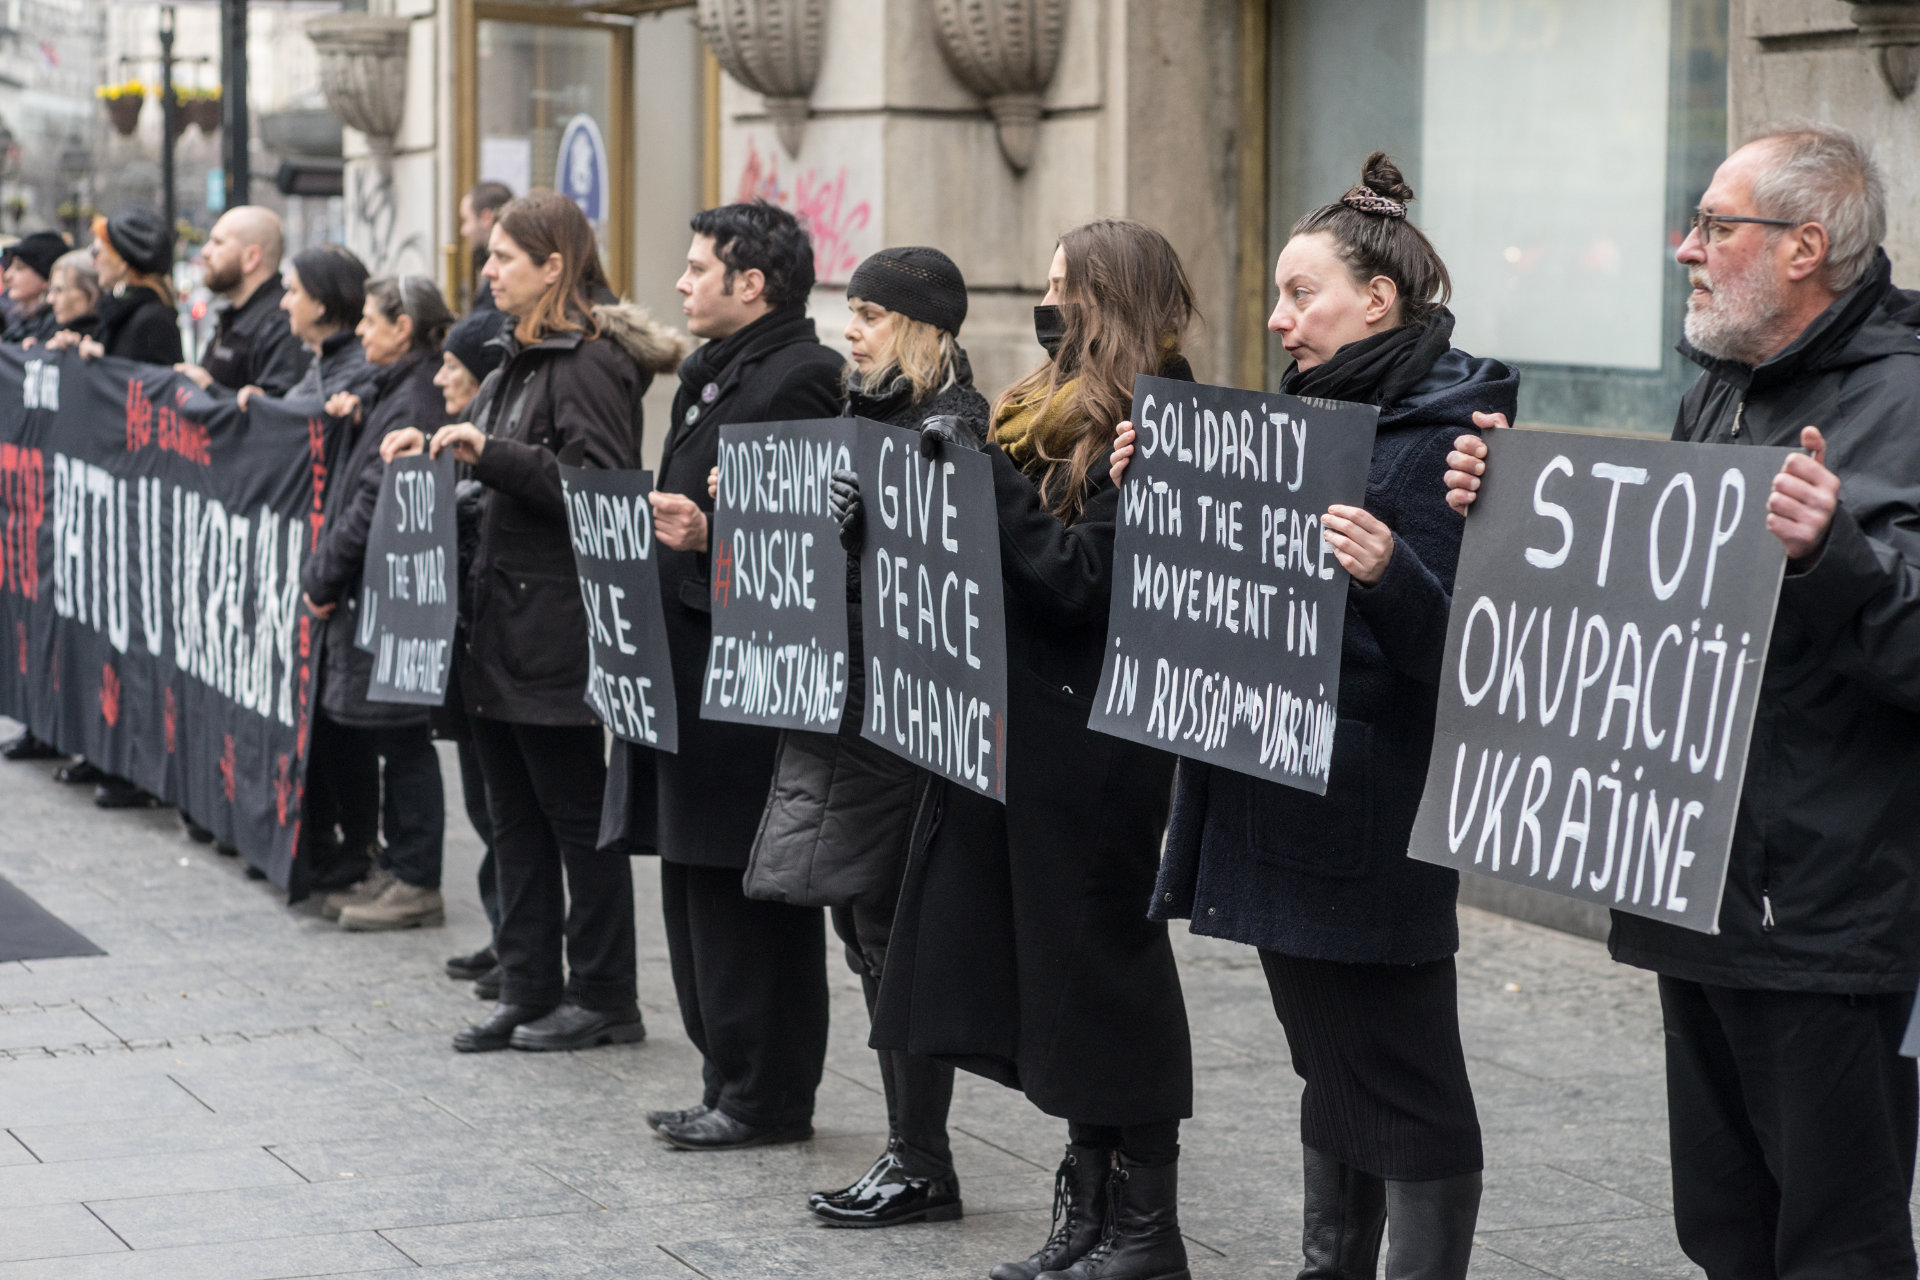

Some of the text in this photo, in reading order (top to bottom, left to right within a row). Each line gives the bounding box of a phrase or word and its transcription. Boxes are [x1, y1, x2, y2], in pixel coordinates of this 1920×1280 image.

[0, 442, 45, 603] TOP
[395, 470, 436, 533] STOP
[878, 437, 959, 553] GIVE
[1198, 496, 1244, 551] THE
[1261, 504, 1335, 580] PEACE
[1525, 455, 1746, 609] STOP
[386, 545, 447, 606] THE WAR
[877, 547, 981, 670] PEACE
[1132, 553, 1277, 641] MOVEMENT
[872, 656, 887, 735] A
